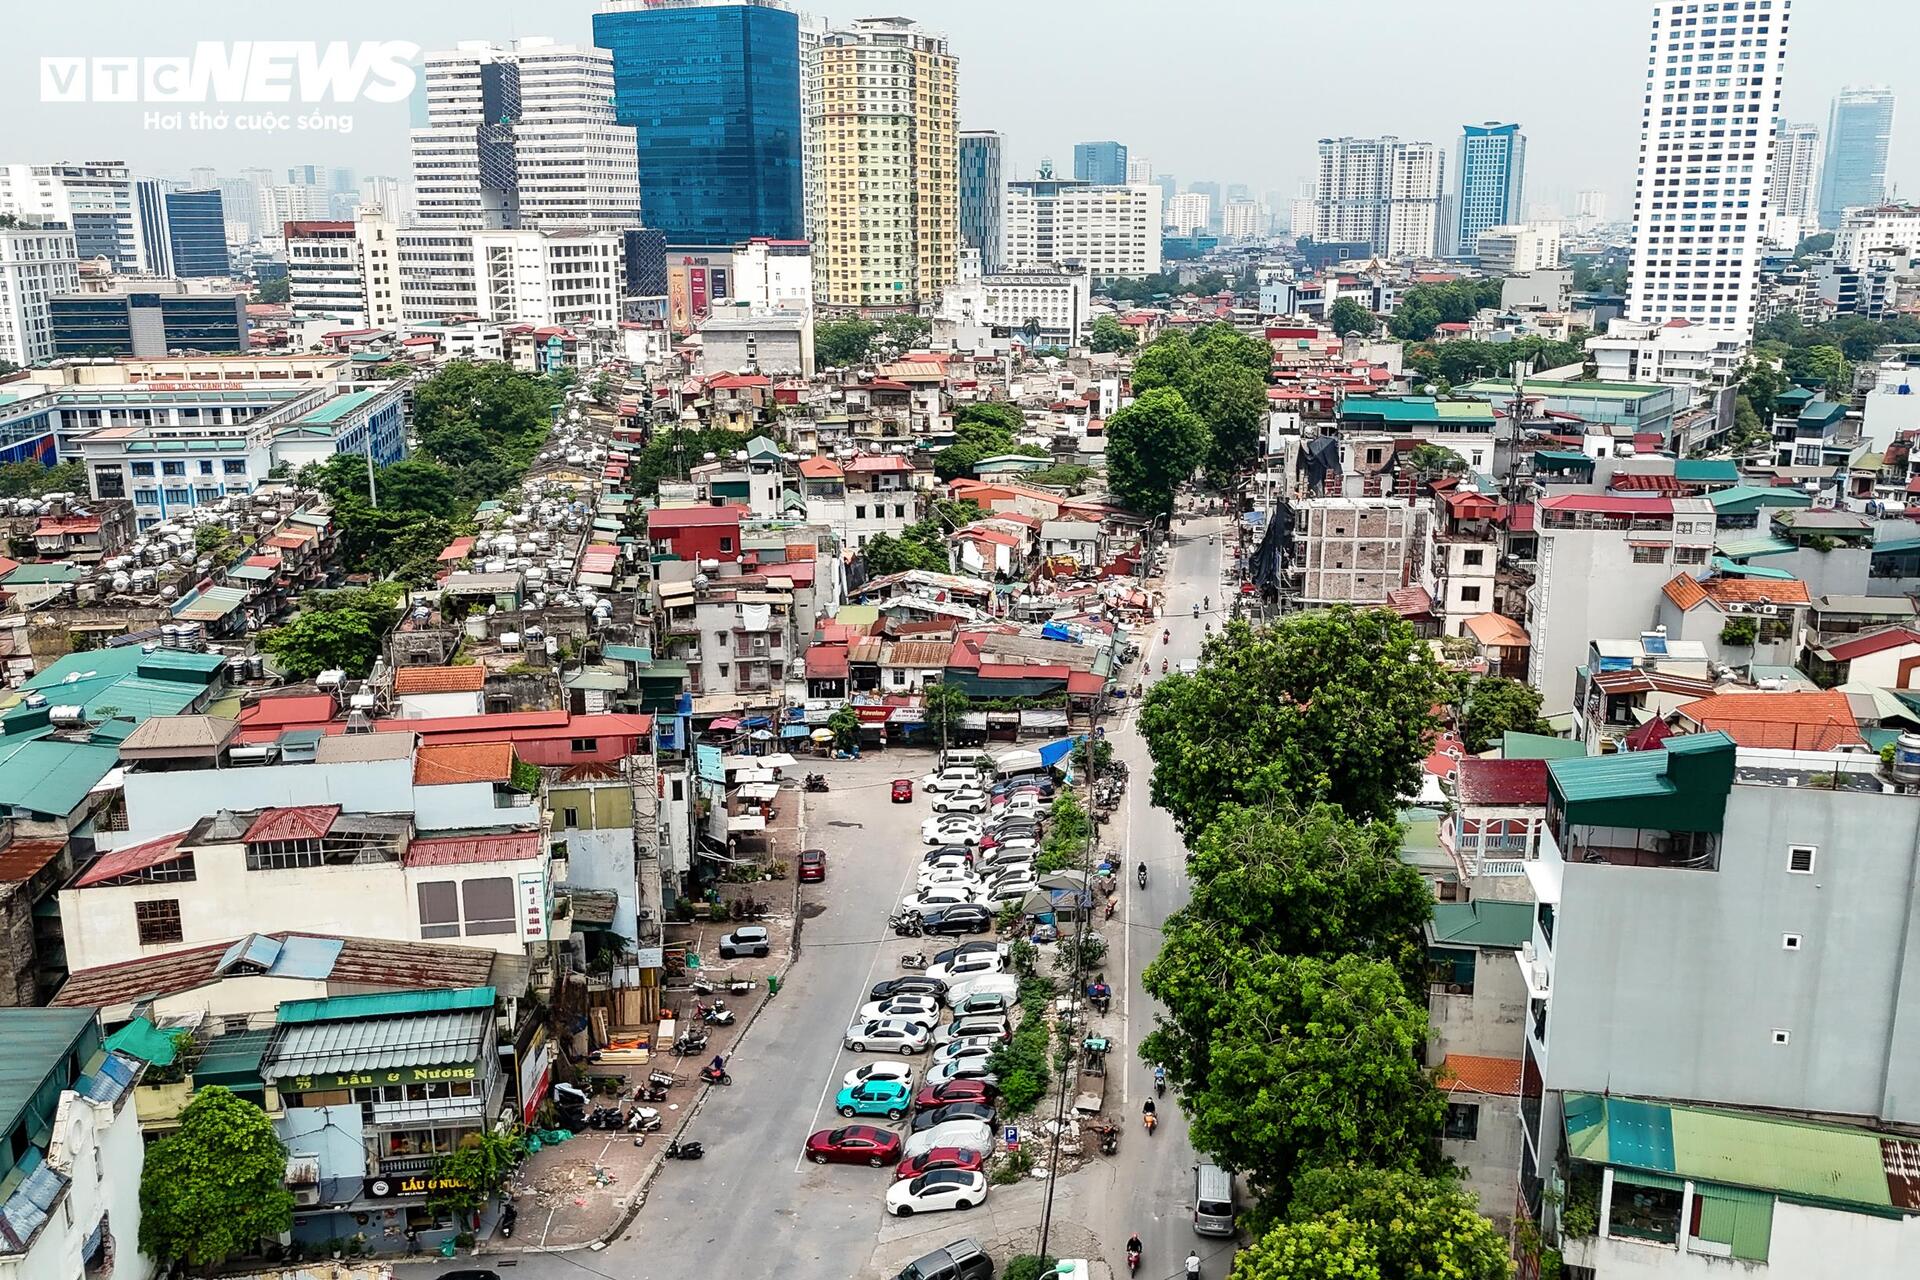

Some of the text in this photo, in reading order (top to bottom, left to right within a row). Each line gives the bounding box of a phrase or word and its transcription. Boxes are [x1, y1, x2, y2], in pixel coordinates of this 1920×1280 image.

[387, 1072, 400, 1082] &
[296, 1082, 312, 1090] 79
[1007, 1129, 1015, 1138] P
